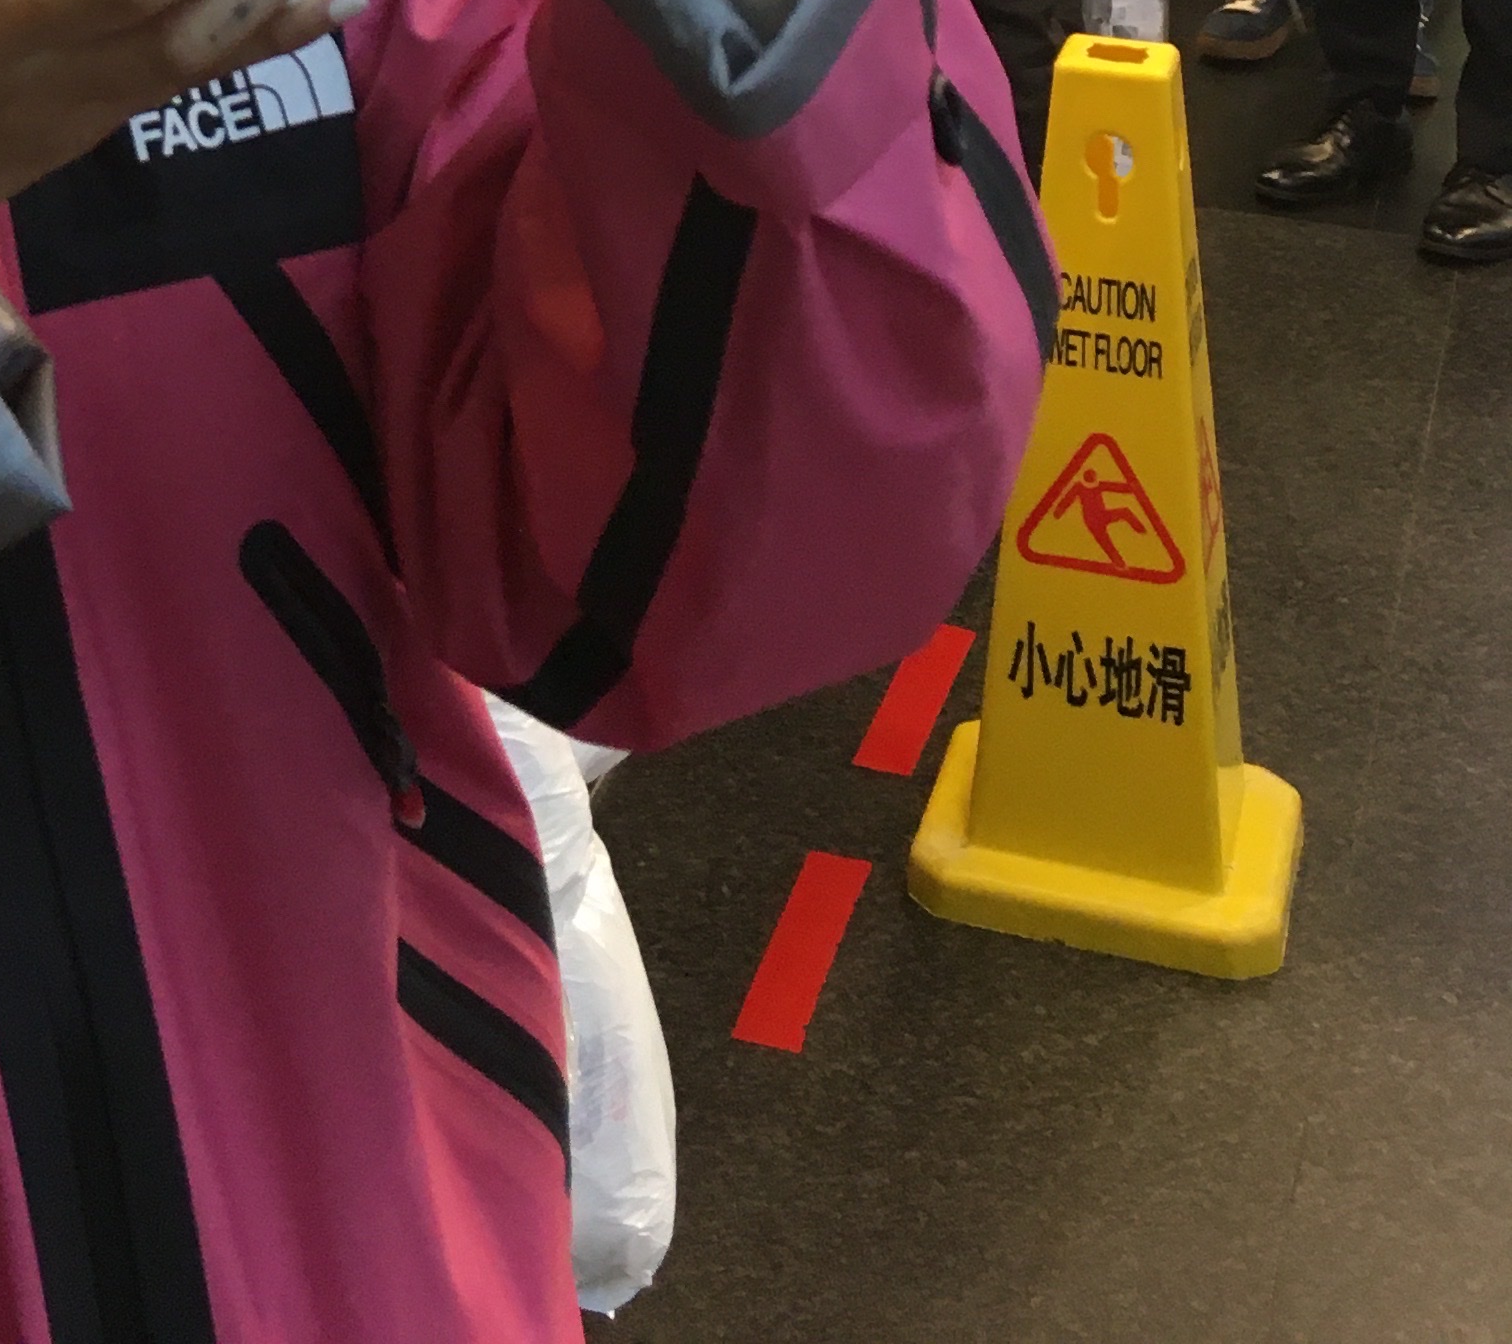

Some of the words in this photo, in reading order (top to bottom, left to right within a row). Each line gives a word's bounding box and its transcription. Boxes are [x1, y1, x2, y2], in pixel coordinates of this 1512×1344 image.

[129, 89, 262, 163] FACE
[1094, 332, 1162, 379] FLOOR
[1007, 621, 1192, 727] 小心地滑
